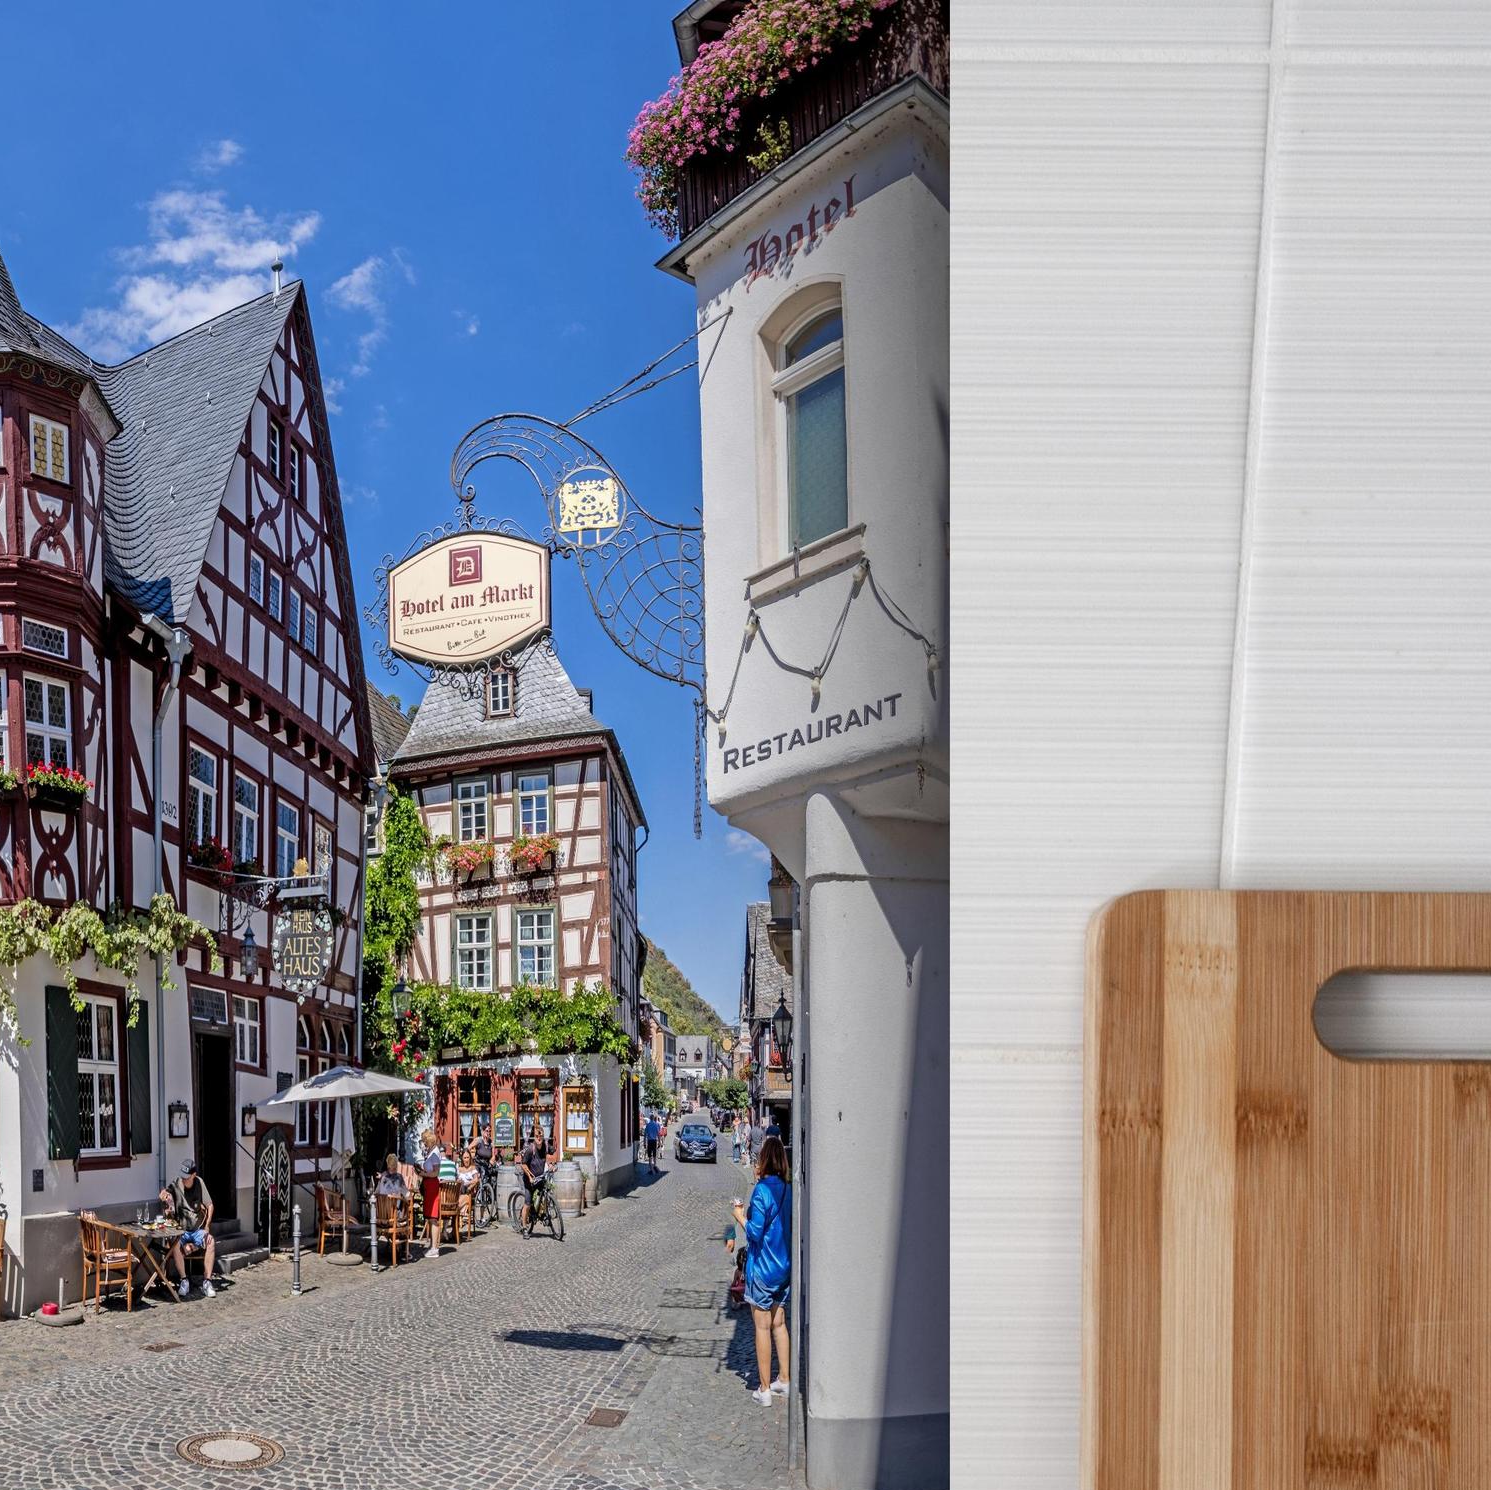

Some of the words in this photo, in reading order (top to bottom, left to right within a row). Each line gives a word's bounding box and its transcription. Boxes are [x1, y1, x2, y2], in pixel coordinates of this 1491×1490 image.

[744, 174, 859, 293] Hotel
[400, 594, 445, 620] Hotel
[450, 594, 475, 609] am
[479, 583, 535, 608] Markt
[723, 693, 903, 775] RESTAURANT
[293, 909, 311, 922] WEIN
[292, 922, 313, 934] HAUS
[283, 936, 321, 956] ALTES
[283, 956, 320, 976] HAUS
